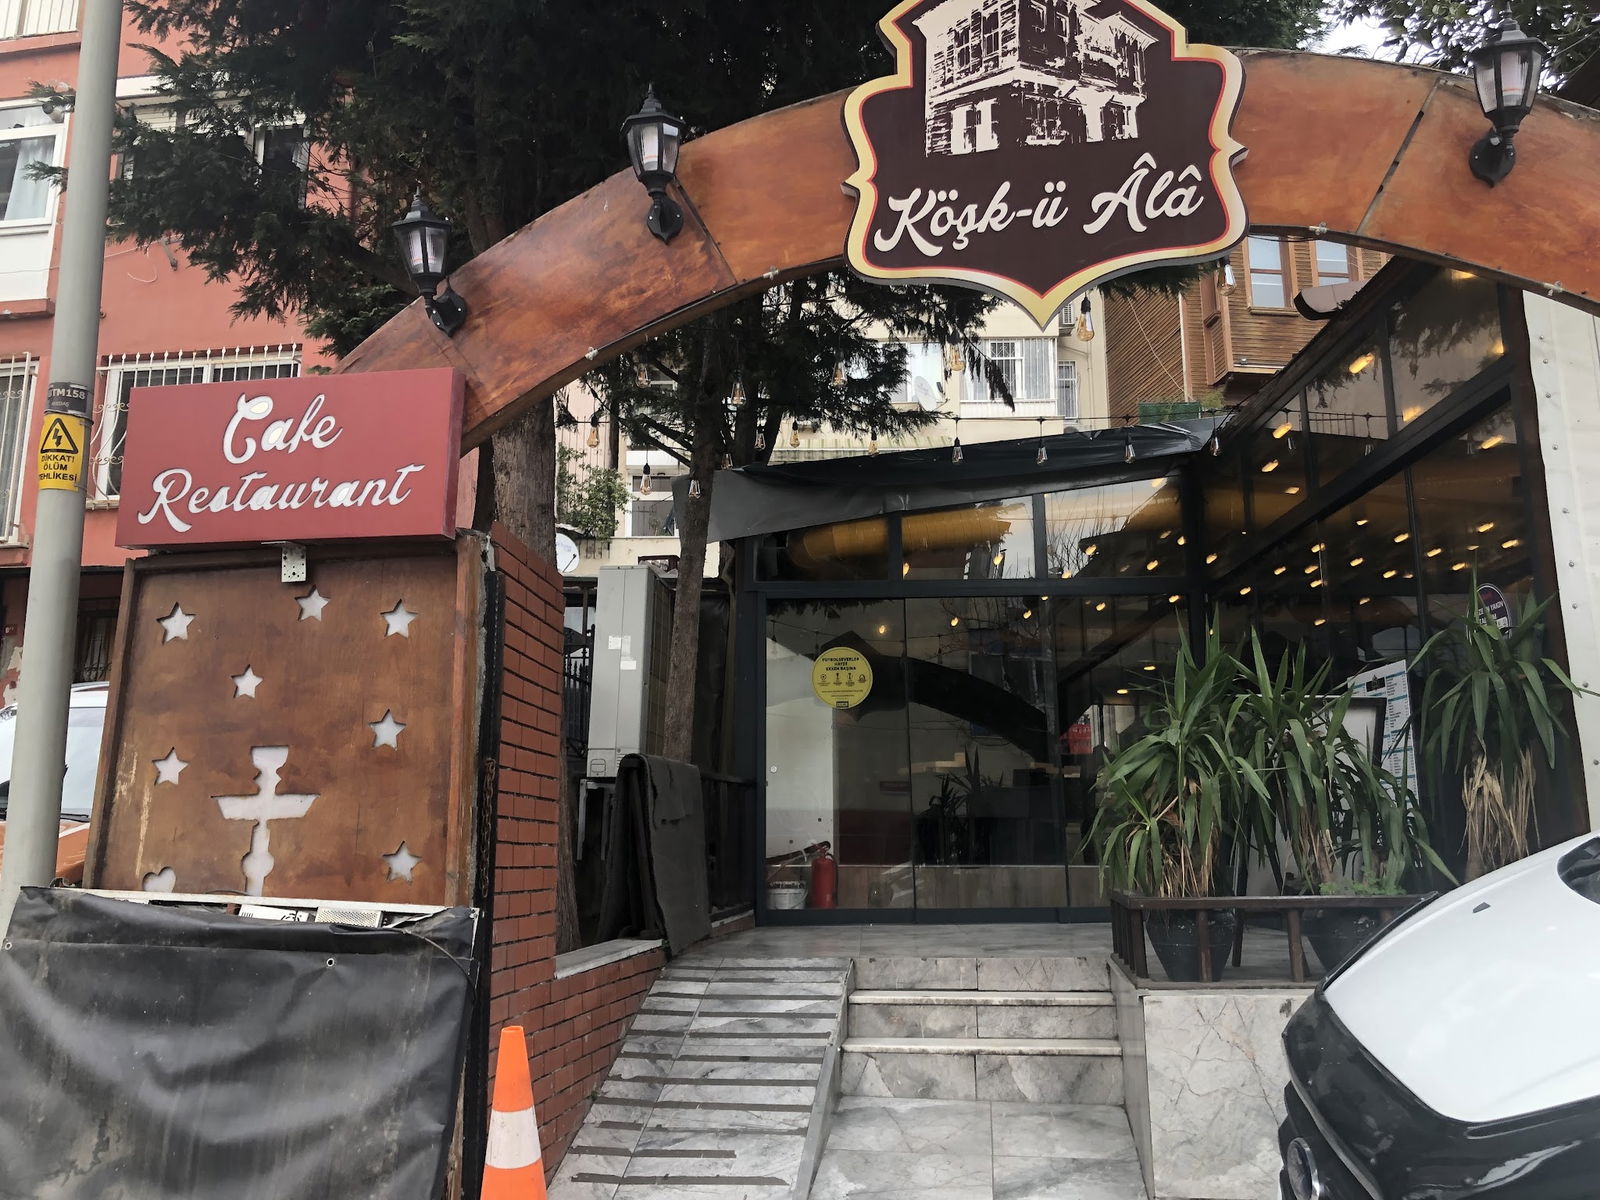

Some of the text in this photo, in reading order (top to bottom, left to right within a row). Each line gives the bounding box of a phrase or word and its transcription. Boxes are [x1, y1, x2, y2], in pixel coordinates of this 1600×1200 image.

[873, 152, 1204, 257] Köşk-ü Âlâ
[222, 393, 343, 464] Cafe
[39, 471, 77, 482] EHLİKESİ
[43, 462, 68, 471] ÖLÜM
[137, 463, 425, 533] Restaurant
